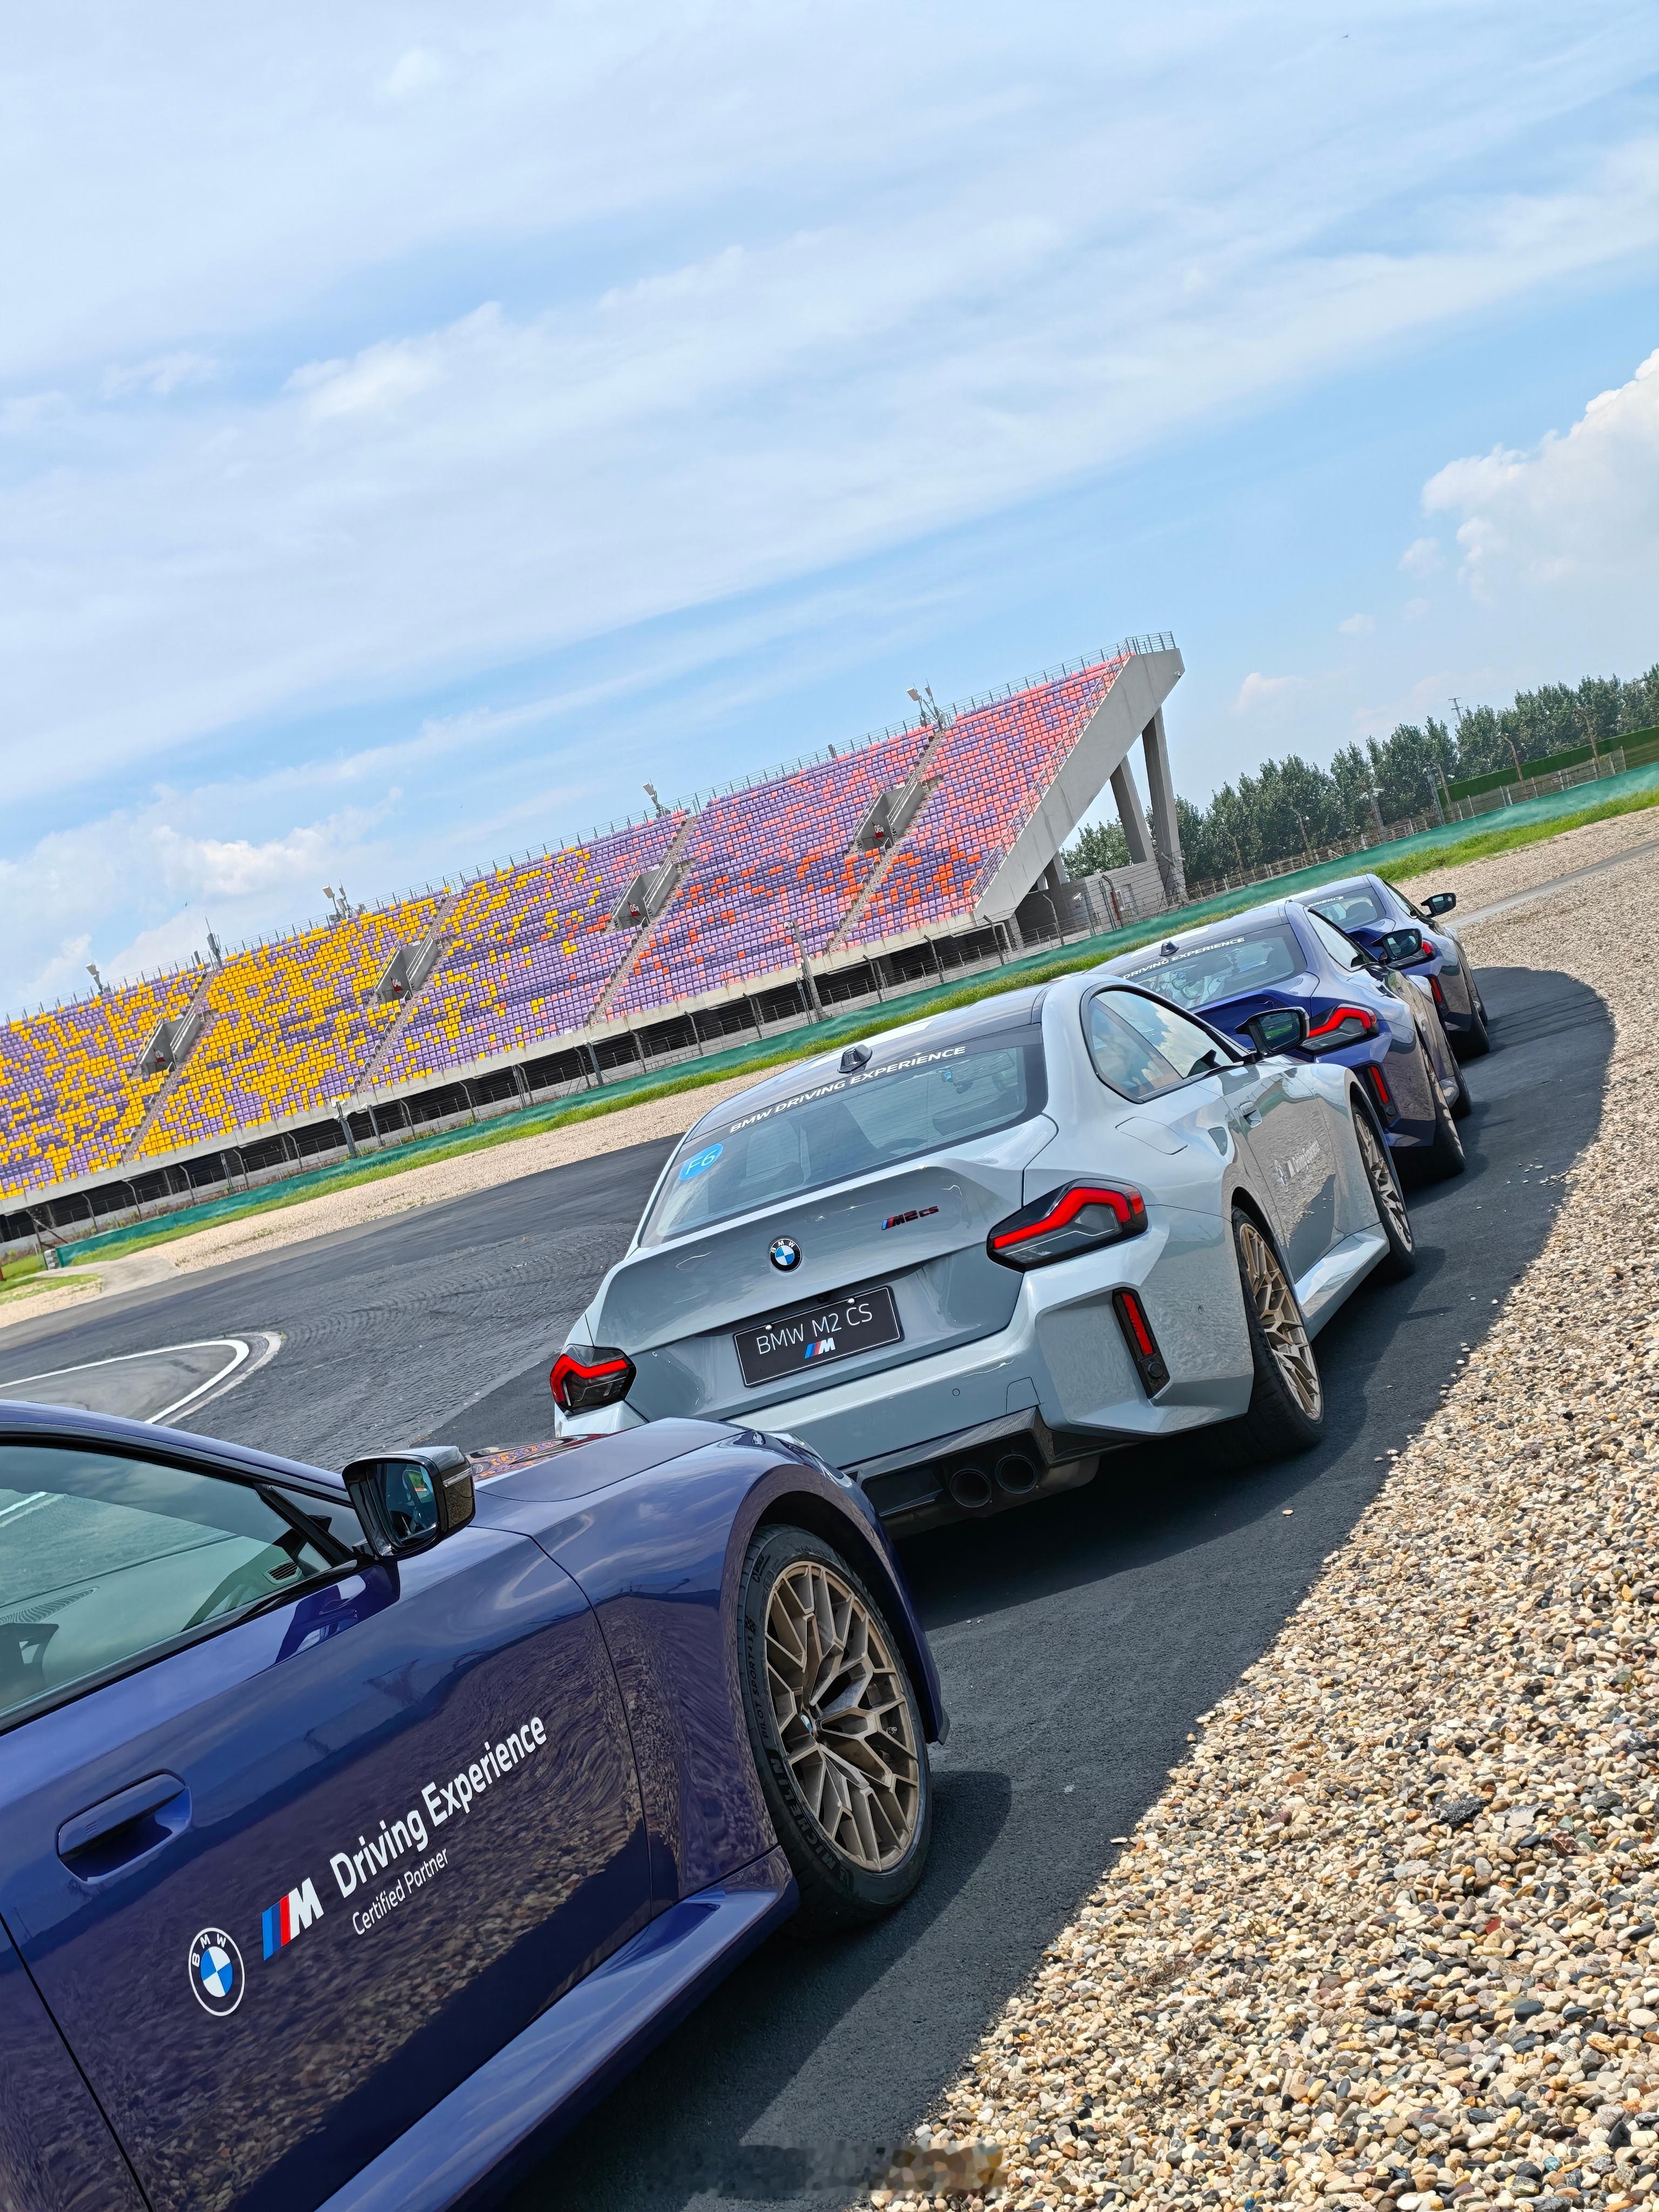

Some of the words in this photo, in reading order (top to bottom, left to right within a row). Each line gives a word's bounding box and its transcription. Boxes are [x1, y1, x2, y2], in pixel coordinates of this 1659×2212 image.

[1171, 937, 1245, 961] EXPERIENCE
[730, 1108, 773, 1134] BMW
[774, 1080, 846, 1114] DRIVING
[850, 1046, 968, 1085] EXPERIENCE
[685, 1149, 718, 1176] F6
[771, 1240, 795, 1253] BMW
[756, 1323, 804, 1355] BMW
[812, 1313, 842, 1337] M2
[846, 1303, 873, 1326] CS
[329, 1810, 429, 1898] Driving
[421, 1717, 547, 1827] Experience
[769, 1757, 837, 1871] MICHELIN
[352, 1879, 406, 1935] Certified
[403, 1848, 448, 1894] Partner
[192, 1933, 226, 1967] BMW
